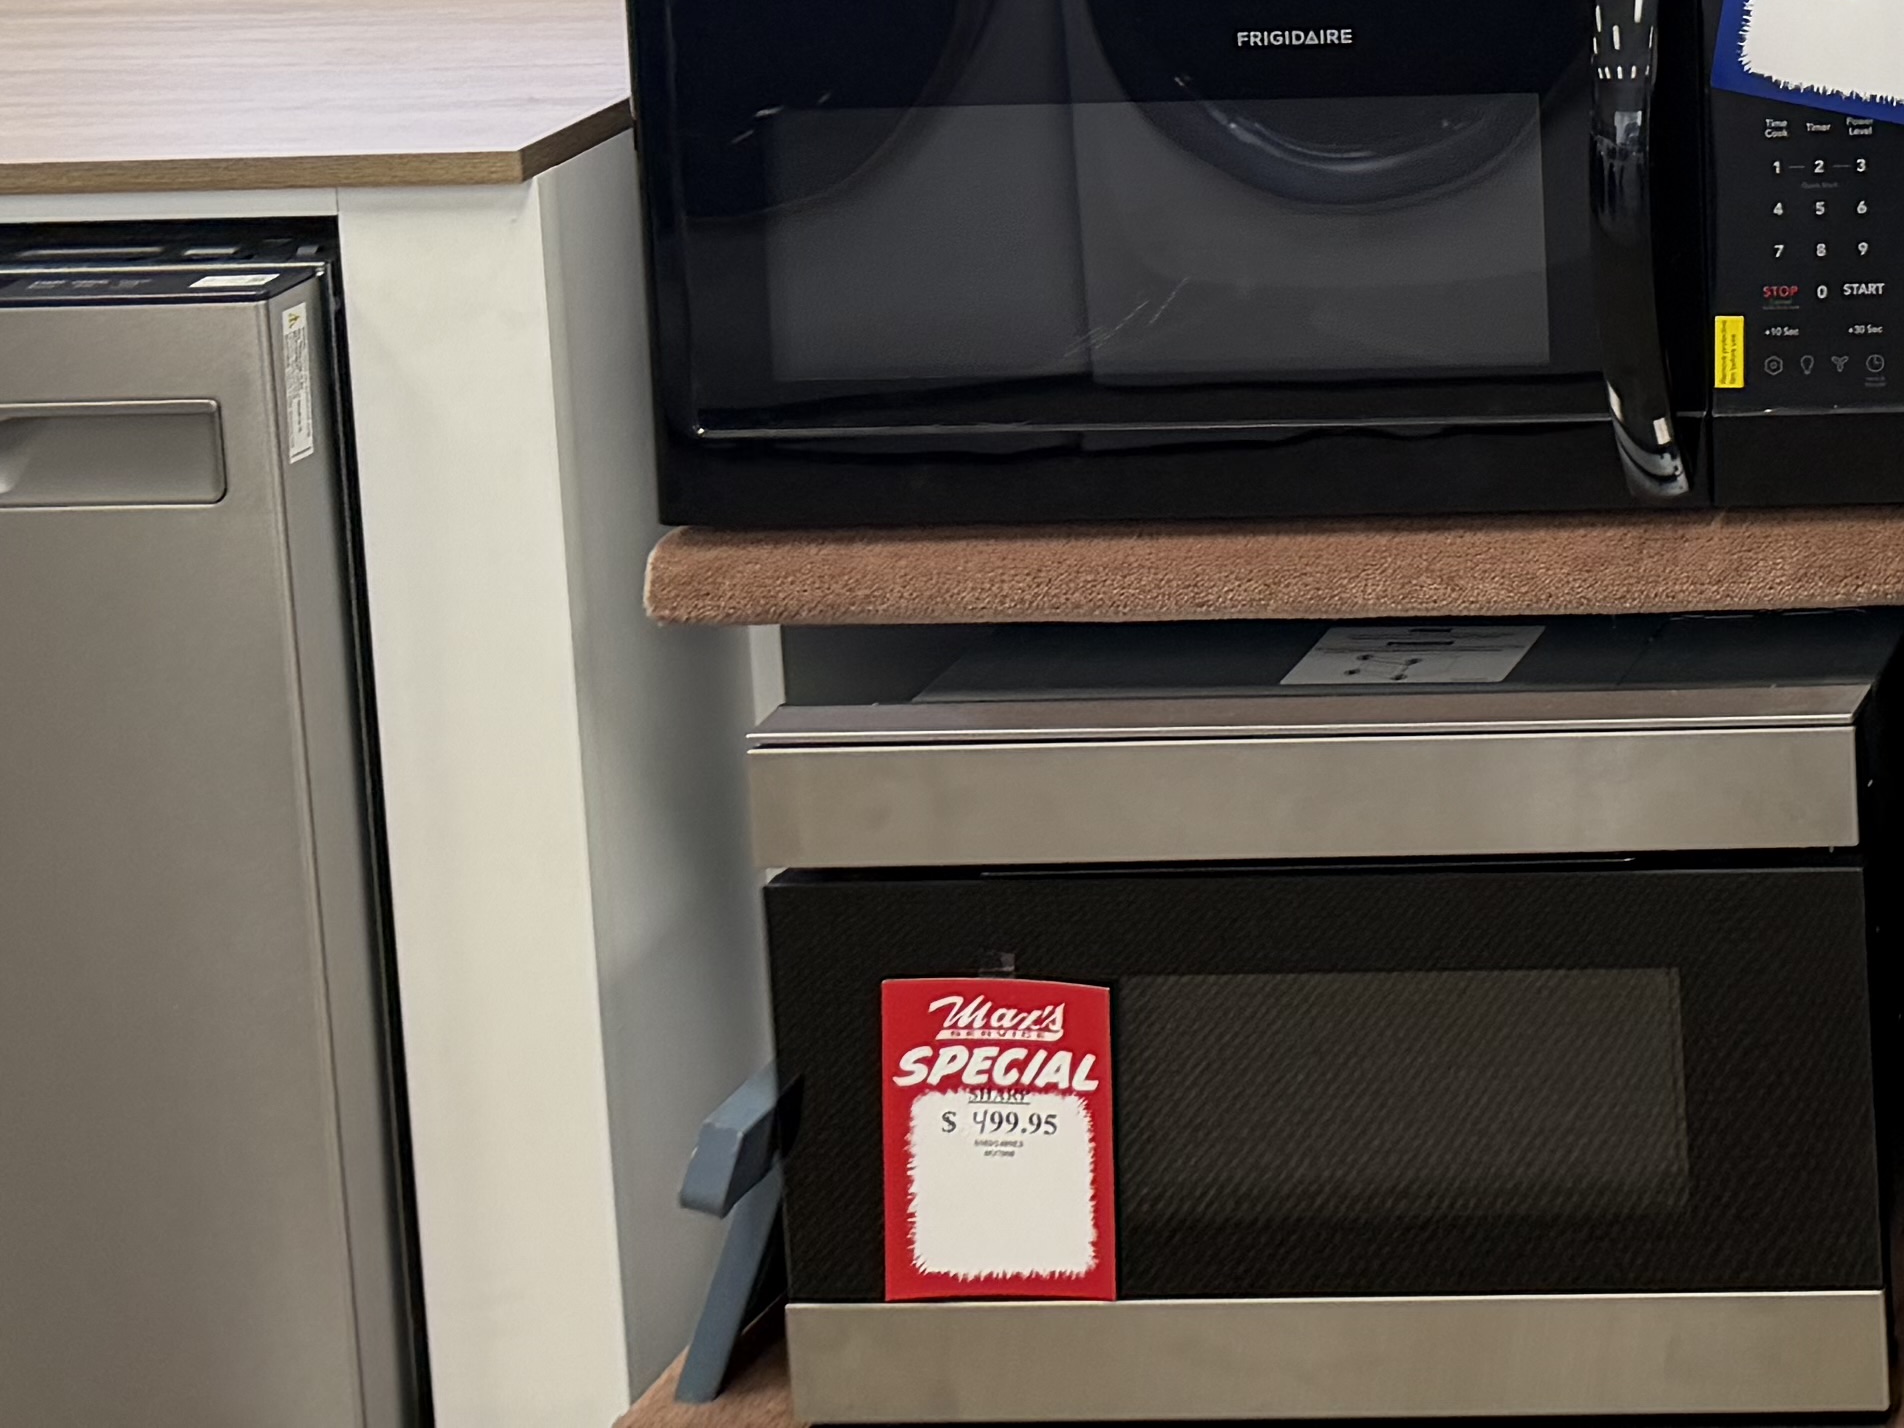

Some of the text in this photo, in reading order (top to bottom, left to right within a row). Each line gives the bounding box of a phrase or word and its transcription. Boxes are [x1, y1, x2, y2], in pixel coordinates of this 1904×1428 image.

[1237, 29, 1352, 46] FRIGIDAIRE
[1763, 286, 1798, 298] STOP
[1843, 283, 1885, 295] START
[892, 1045, 1099, 1091] SPECIAL
[973, 1109, 1057, 1135] 499.95
